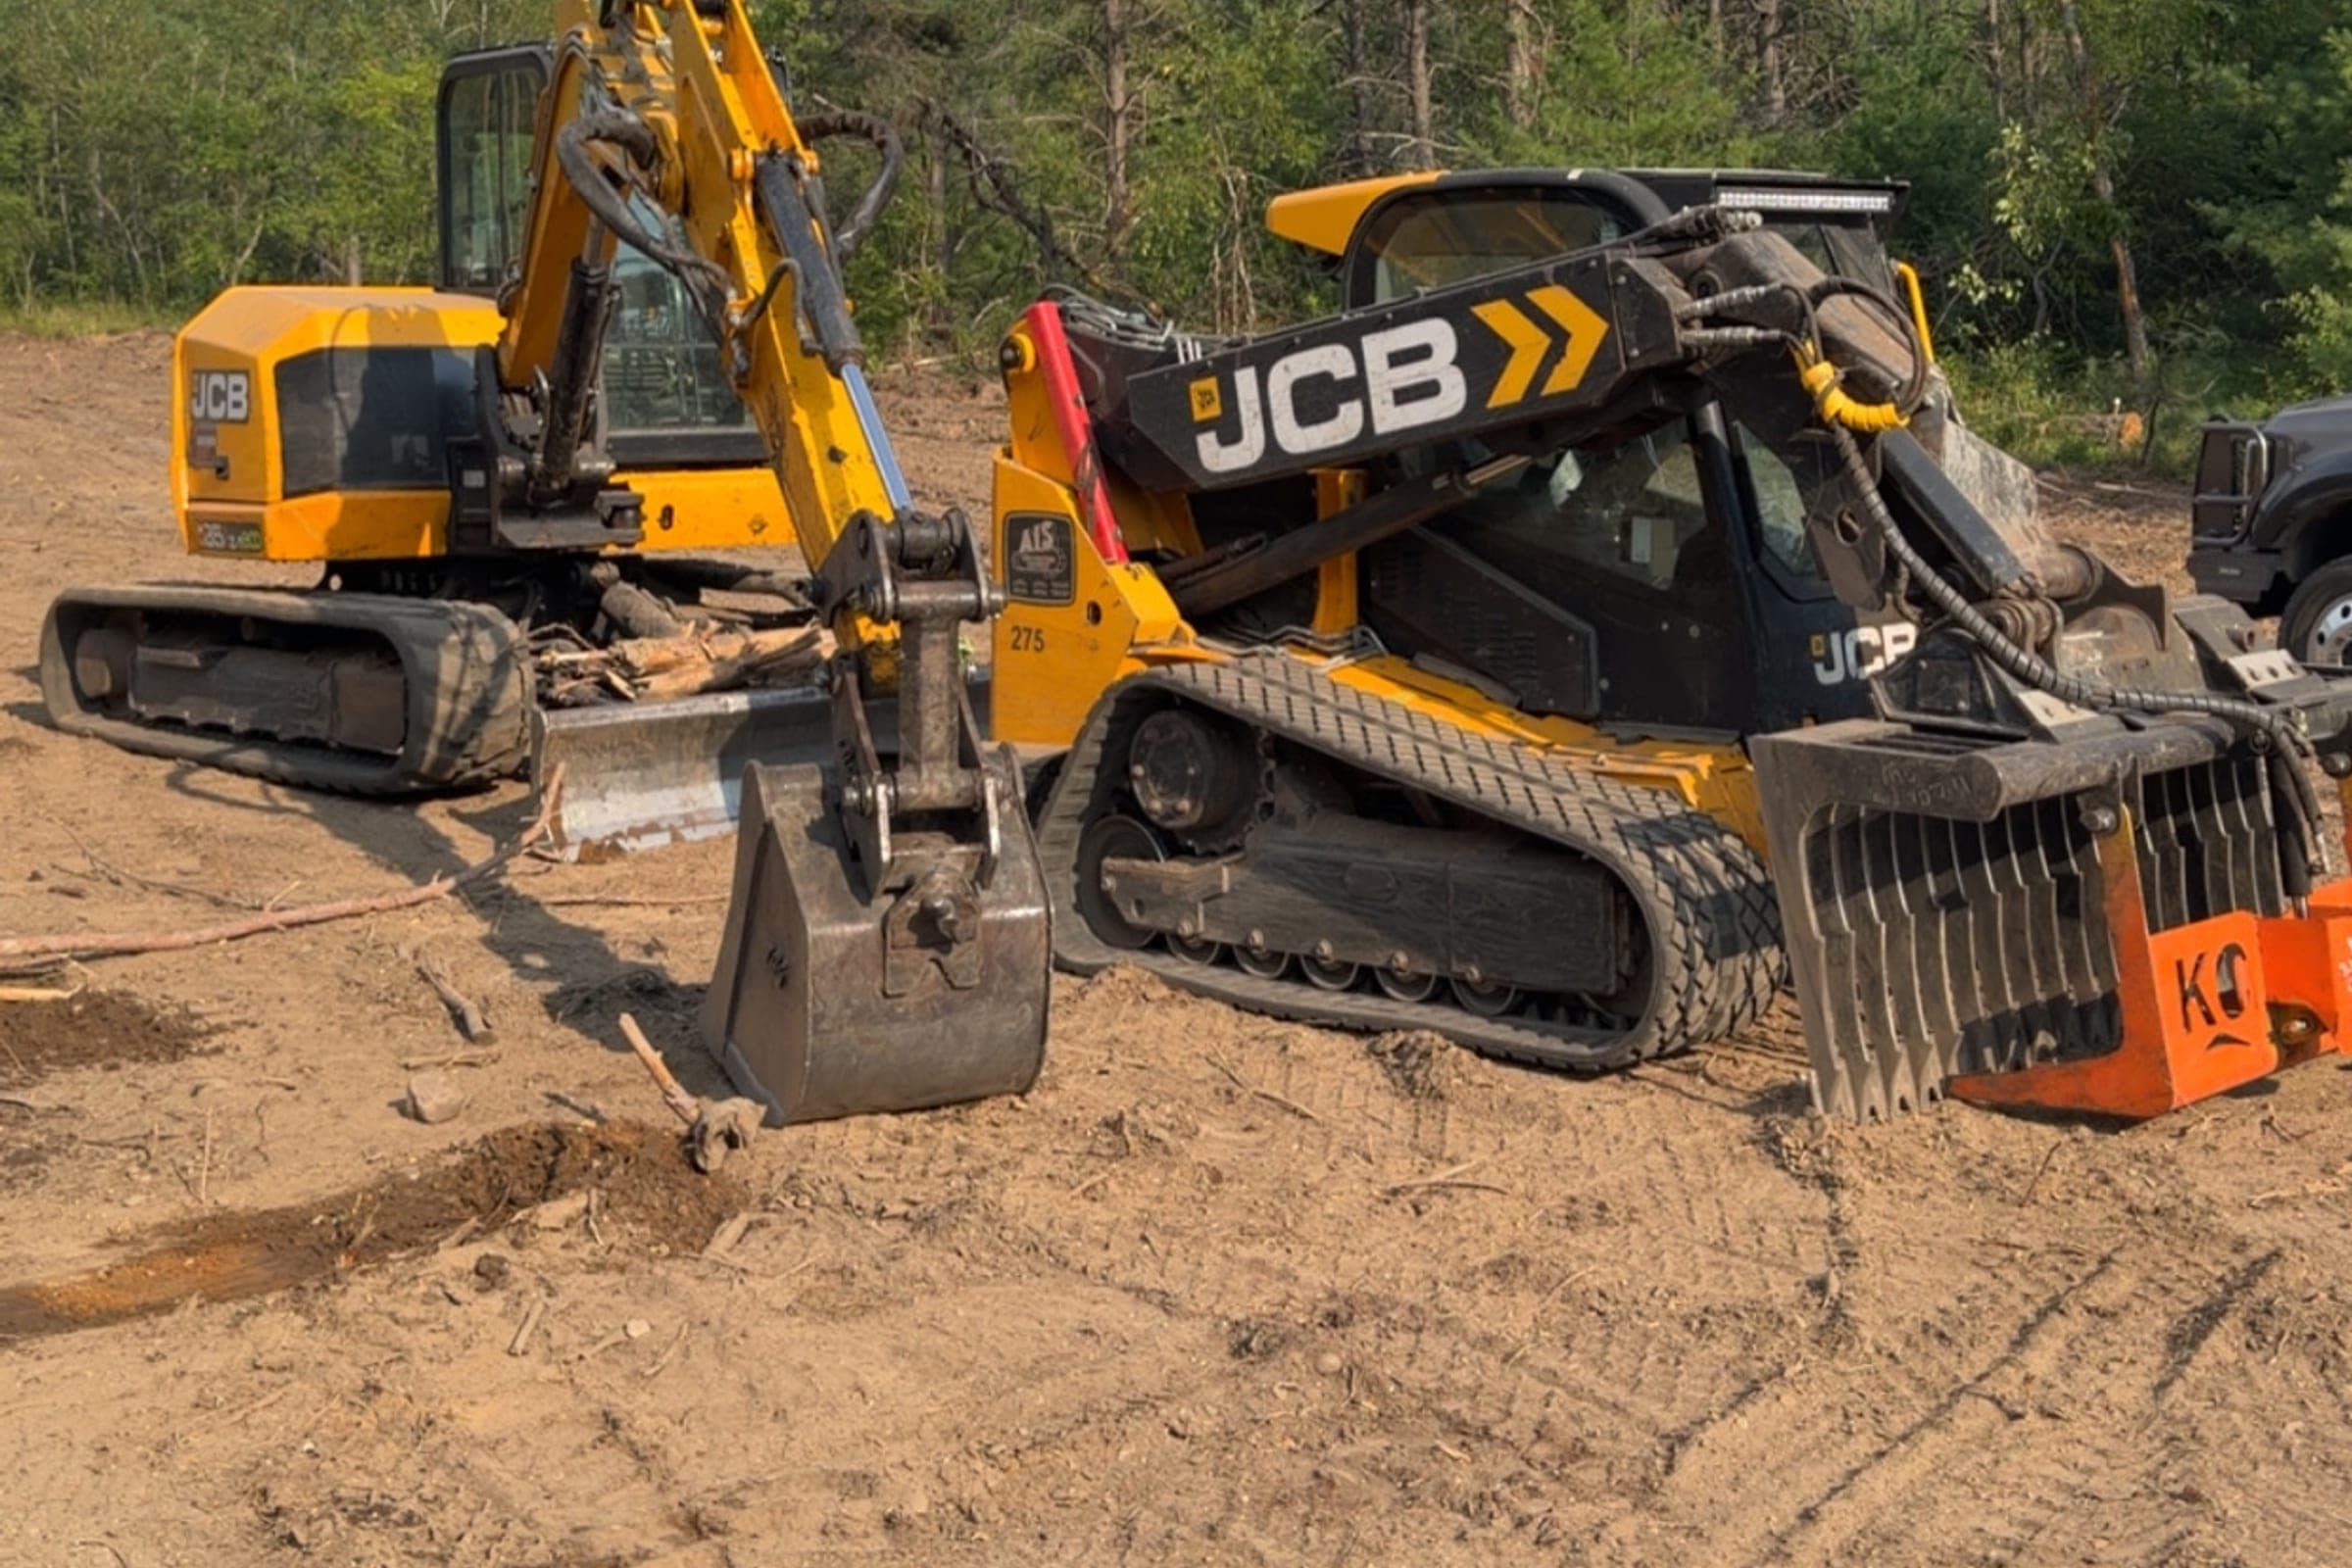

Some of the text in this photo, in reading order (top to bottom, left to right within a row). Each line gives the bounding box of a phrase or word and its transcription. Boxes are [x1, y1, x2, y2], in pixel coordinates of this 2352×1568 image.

[192, 372, 248, 419] JCB
[1196, 317, 1467, 472] JCB
[1010, 624, 1045, 653] 275
